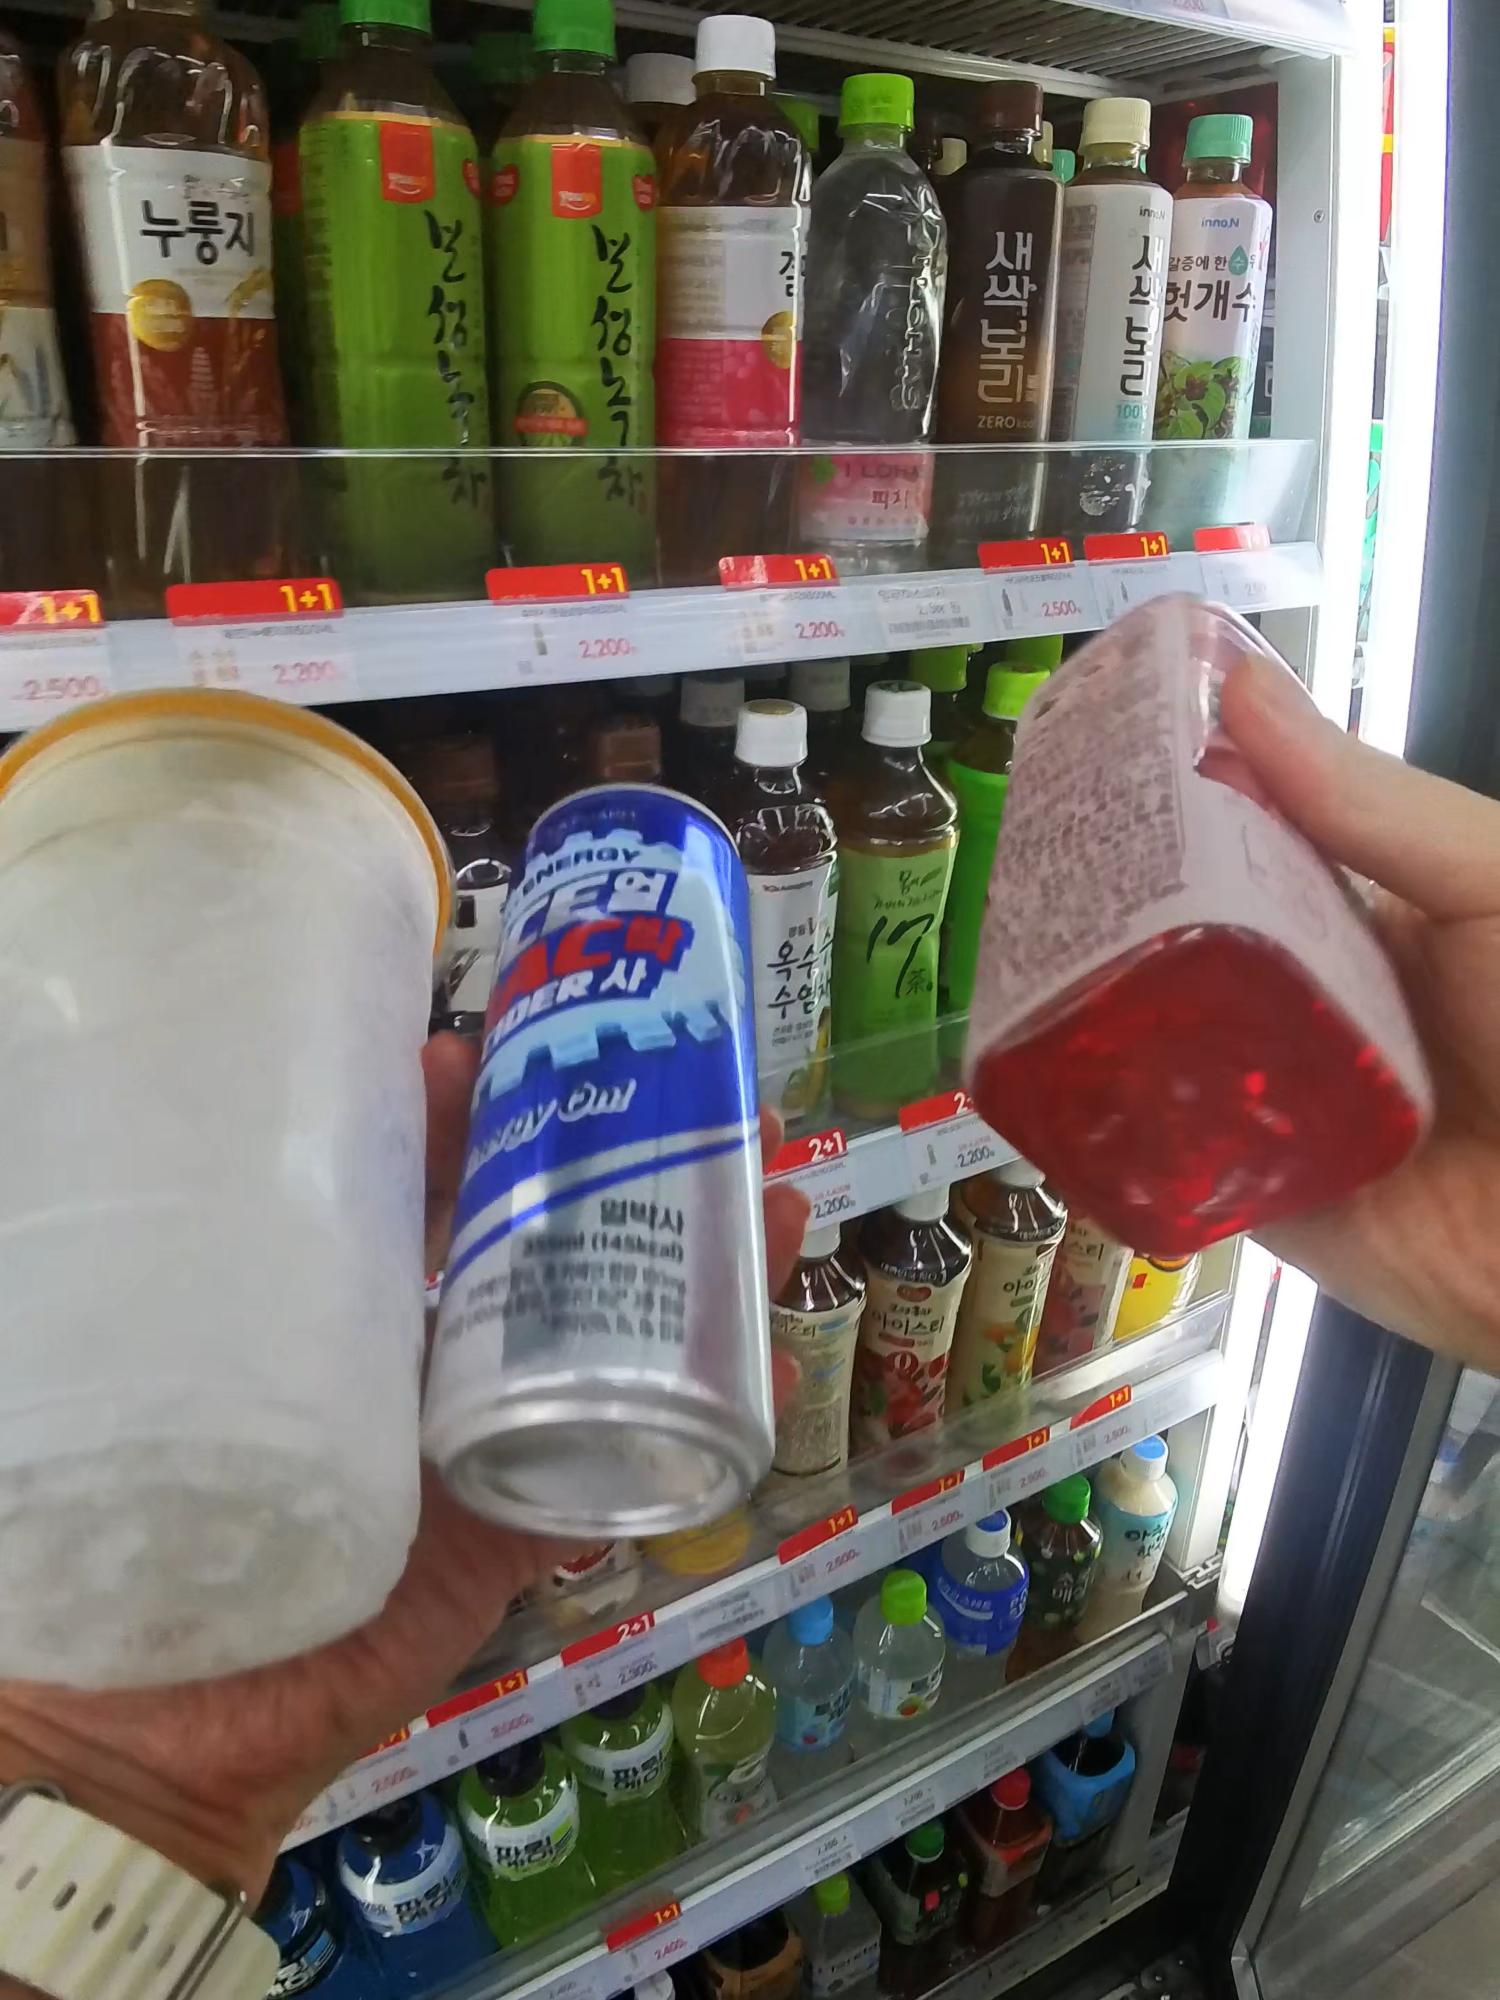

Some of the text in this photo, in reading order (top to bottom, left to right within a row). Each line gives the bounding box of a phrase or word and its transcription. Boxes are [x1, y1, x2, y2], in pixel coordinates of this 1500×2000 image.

[140, 199, 255, 265] 누룽지
[977, 231, 1038, 403] 새싹보리
[977, 415, 1016, 429] ZERO
[1040, 542, 1072, 565] 1+1
[1140, 534, 1168, 557] 1+1
[581, 567, 625, 595] 1+1
[795, 557, 833, 581] 1+1
[40, 595, 101, 624] 1+1
[279, 583, 334, 613] 1+1
[807, 1132, 846, 1160] 2+1
[1109, 1386, 1130, 1408] 1+1
[1027, 1429, 1048, 1452] 1+1
[939, 1472, 962, 1494] 1+1
[828, 1509, 855, 1534] 1+1
[617, 1613, 651, 1644] 2+1
[494, 1671, 528, 1697] 1+1
[654, 1903, 681, 1924] 1+1
